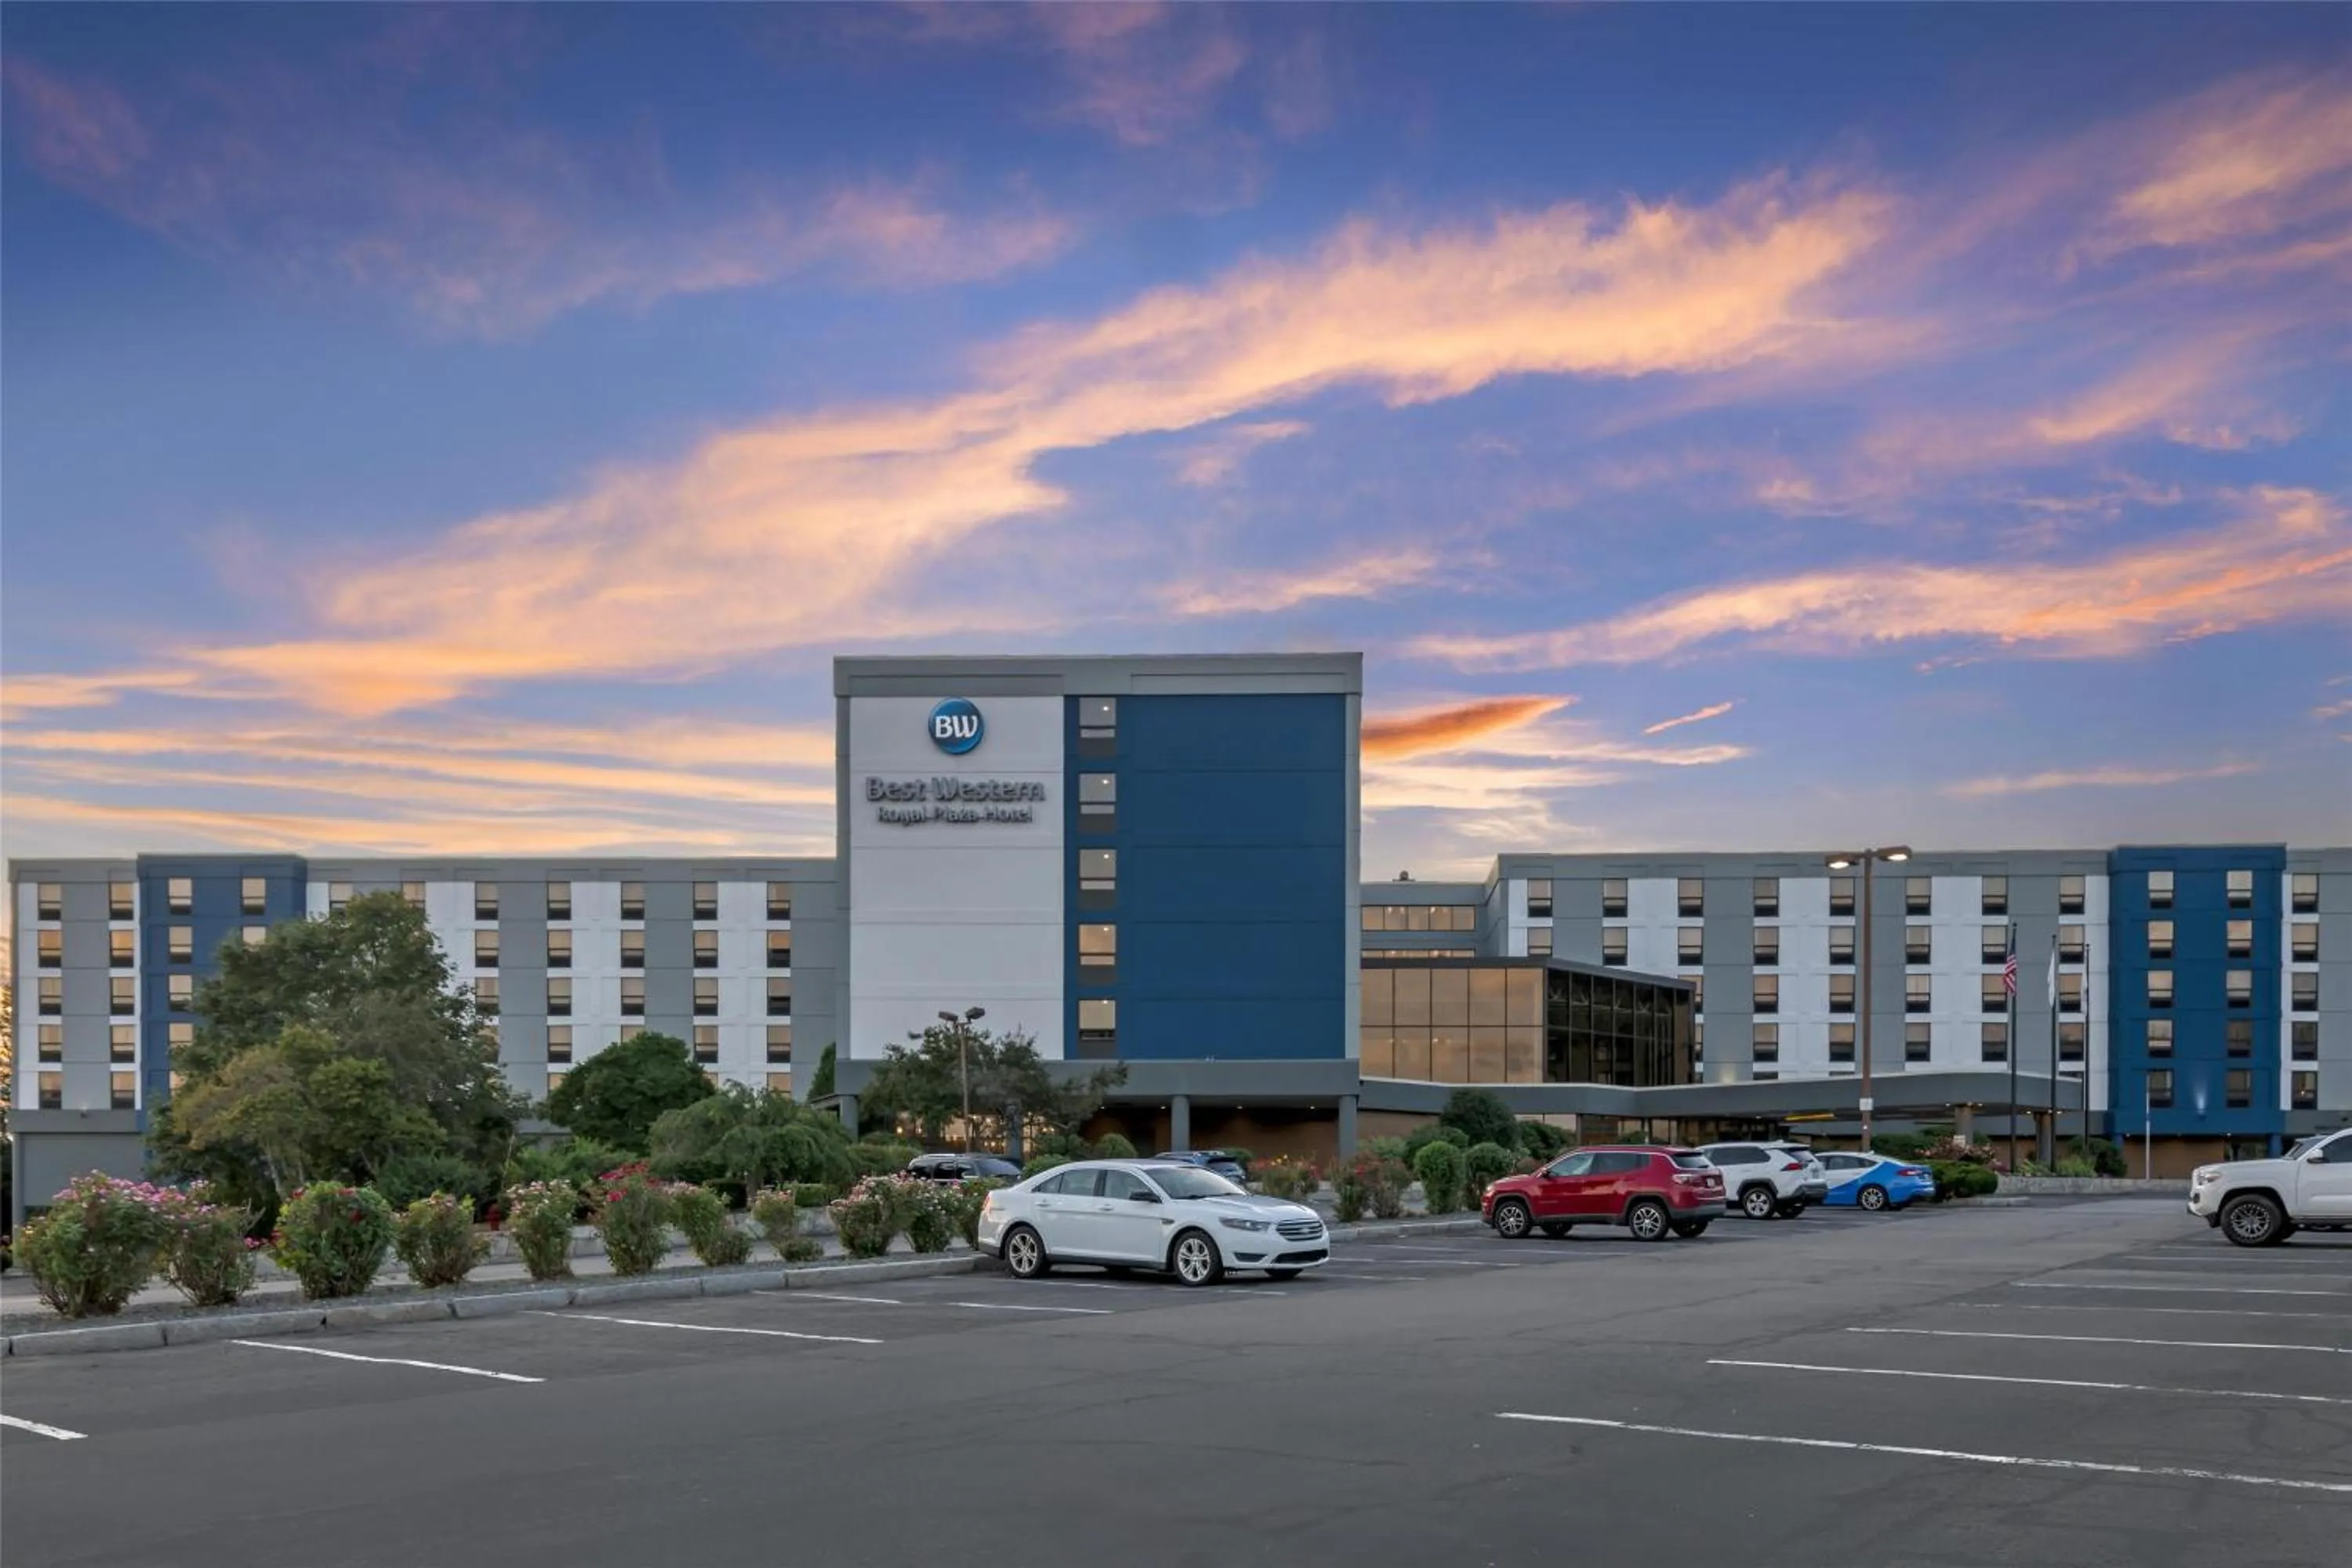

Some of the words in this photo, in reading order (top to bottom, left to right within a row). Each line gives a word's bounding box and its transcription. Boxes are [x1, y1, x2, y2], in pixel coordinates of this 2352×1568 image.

[935, 714, 978, 738] BW
[866, 776, 927, 801] Best
[931, 776, 1045, 801] Western
